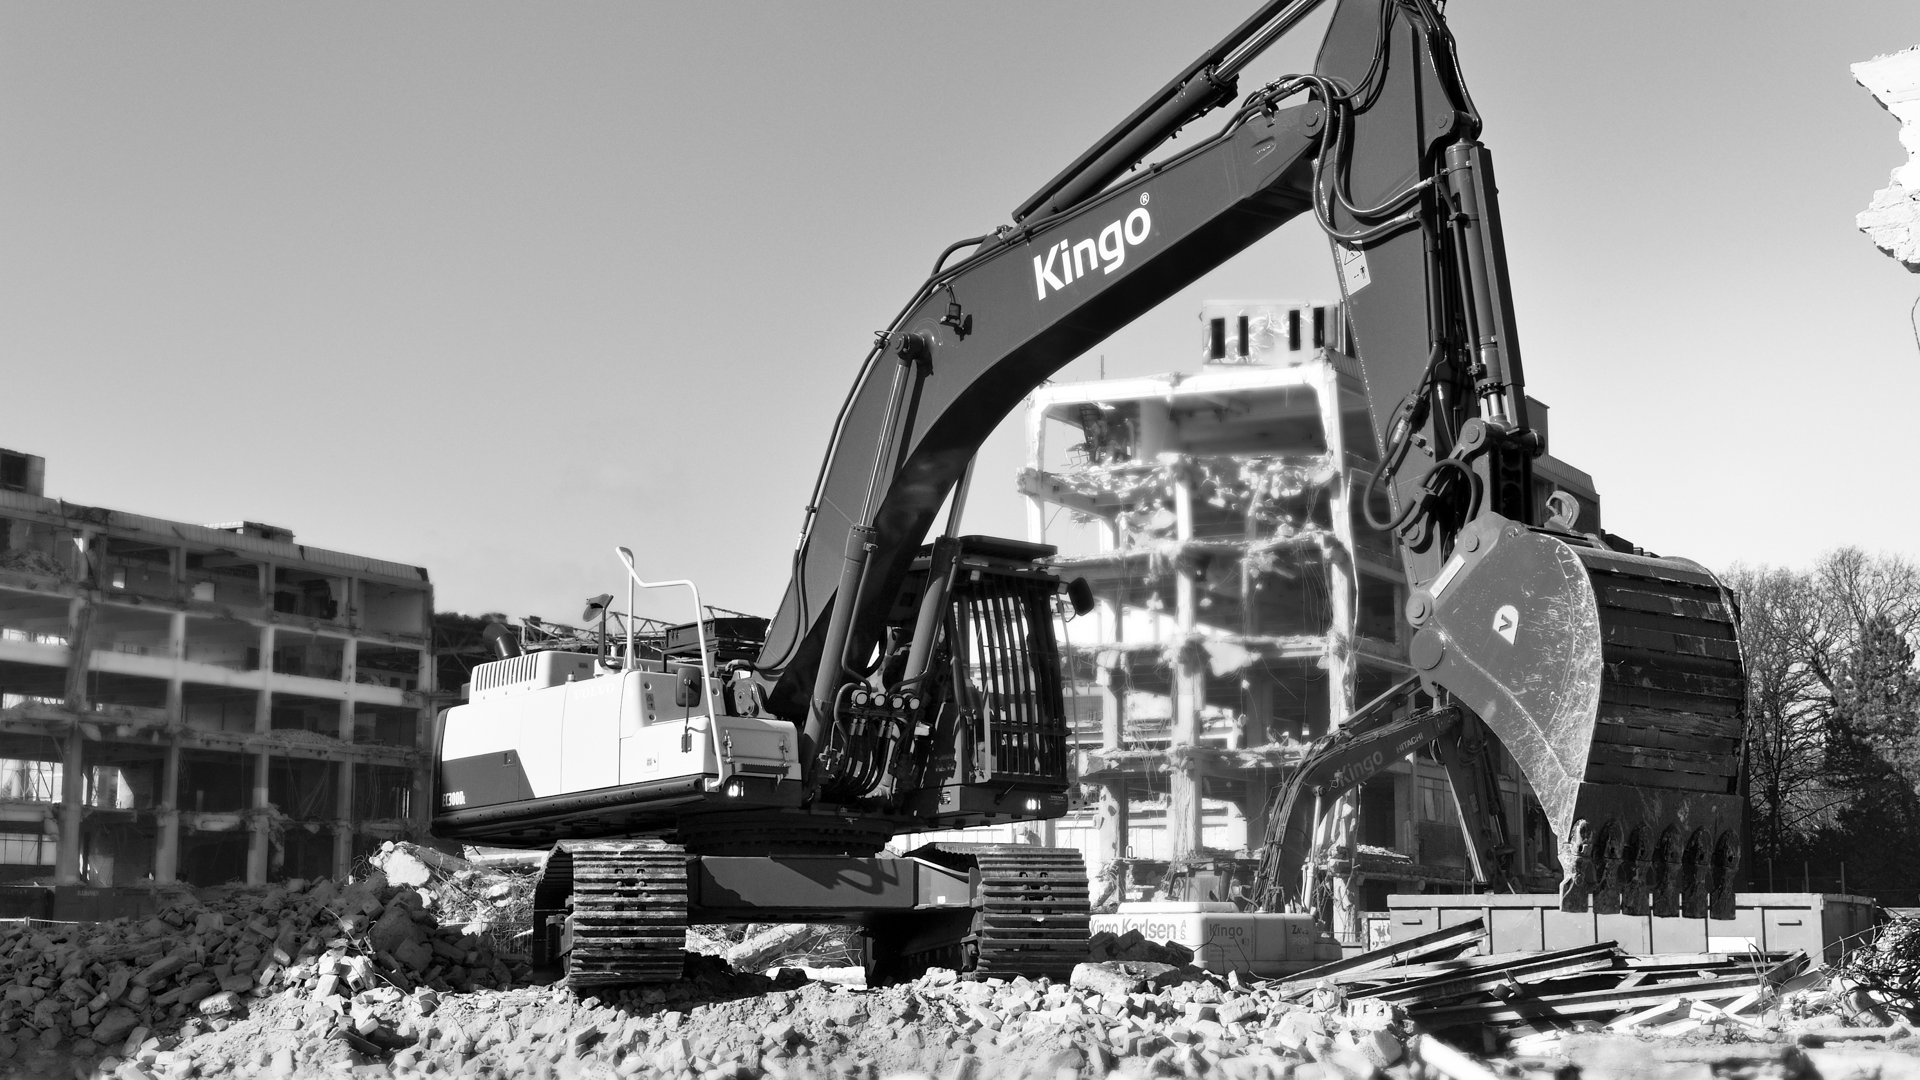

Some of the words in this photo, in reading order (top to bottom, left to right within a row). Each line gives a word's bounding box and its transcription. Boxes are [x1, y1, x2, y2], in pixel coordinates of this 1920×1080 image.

[573, 682, 615, 701] VOLVO
[1395, 732, 1424, 754] HITACHI
[1338, 750, 1383, 787] Kingo
[1209, 923, 1243, 939] Kingo
